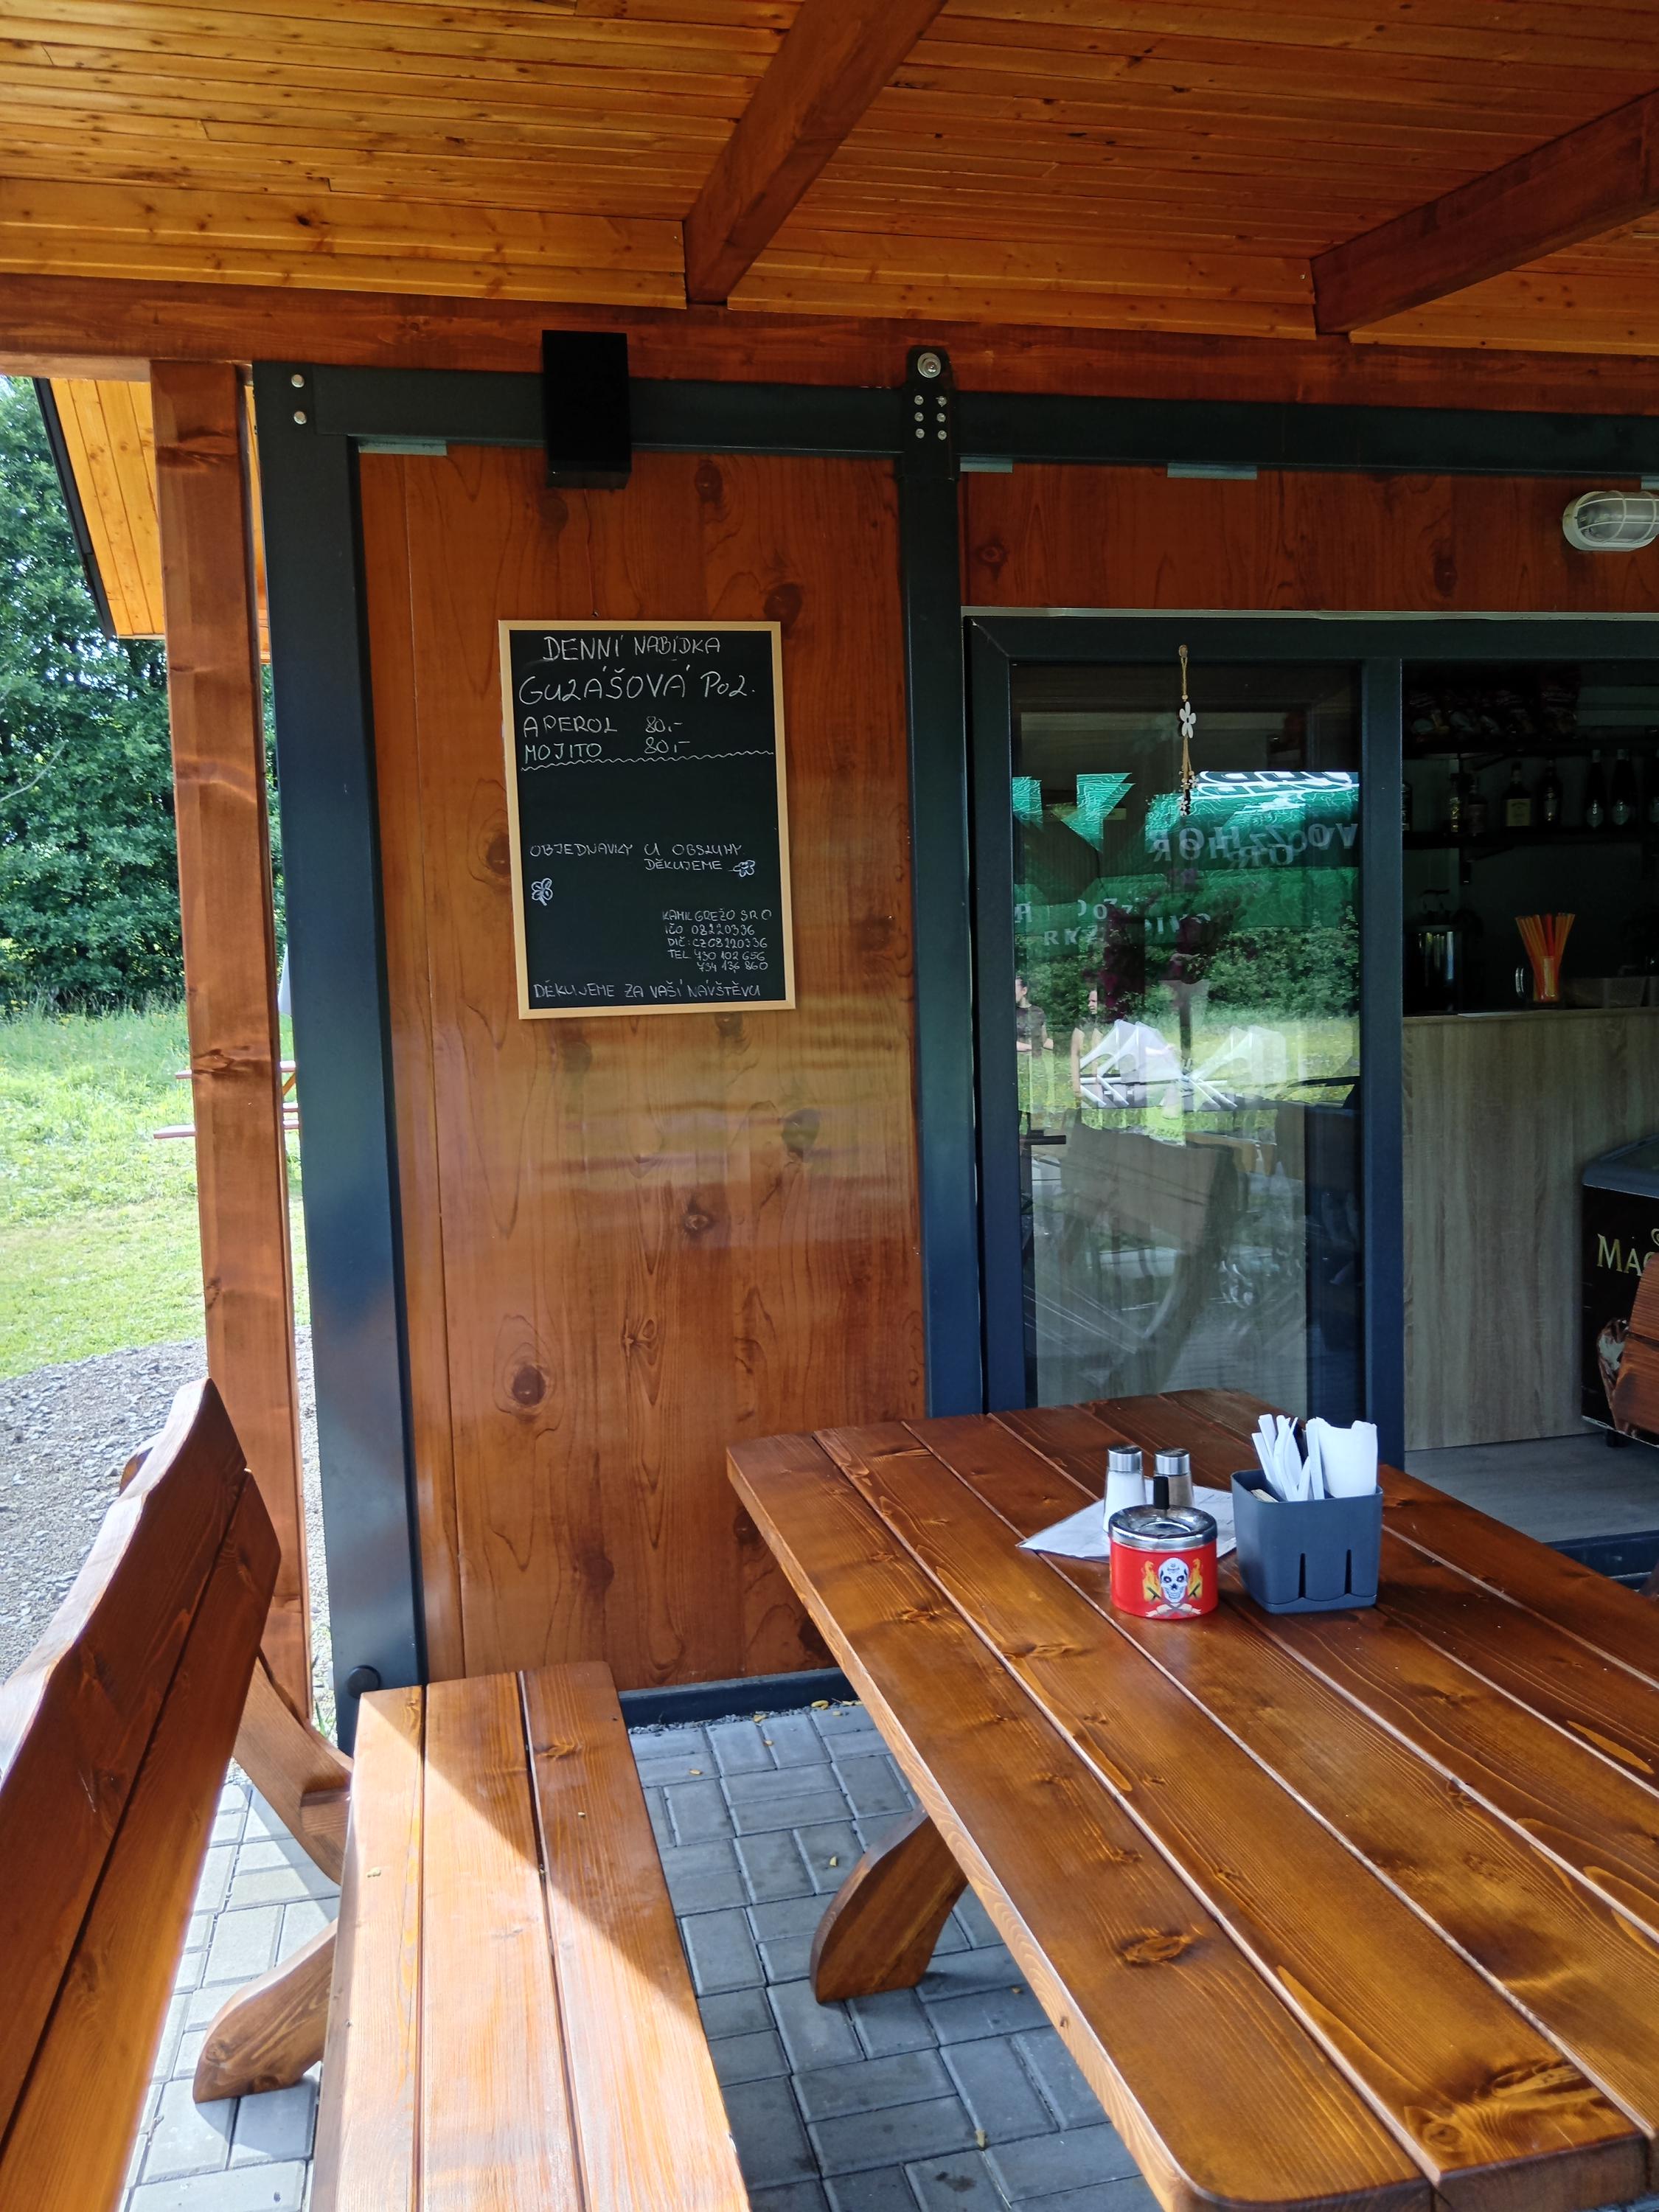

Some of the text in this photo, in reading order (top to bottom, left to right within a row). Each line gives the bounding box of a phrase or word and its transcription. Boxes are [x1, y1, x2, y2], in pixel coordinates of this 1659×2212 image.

[543, 635, 624, 661] DENNÍ
[524, 715, 618, 737] APEROL
[524, 742, 602, 765] MOJITO
[644, 844, 660, 856] U
[667, 949, 690, 959] TEL
[625, 984, 644, 998] ZA
